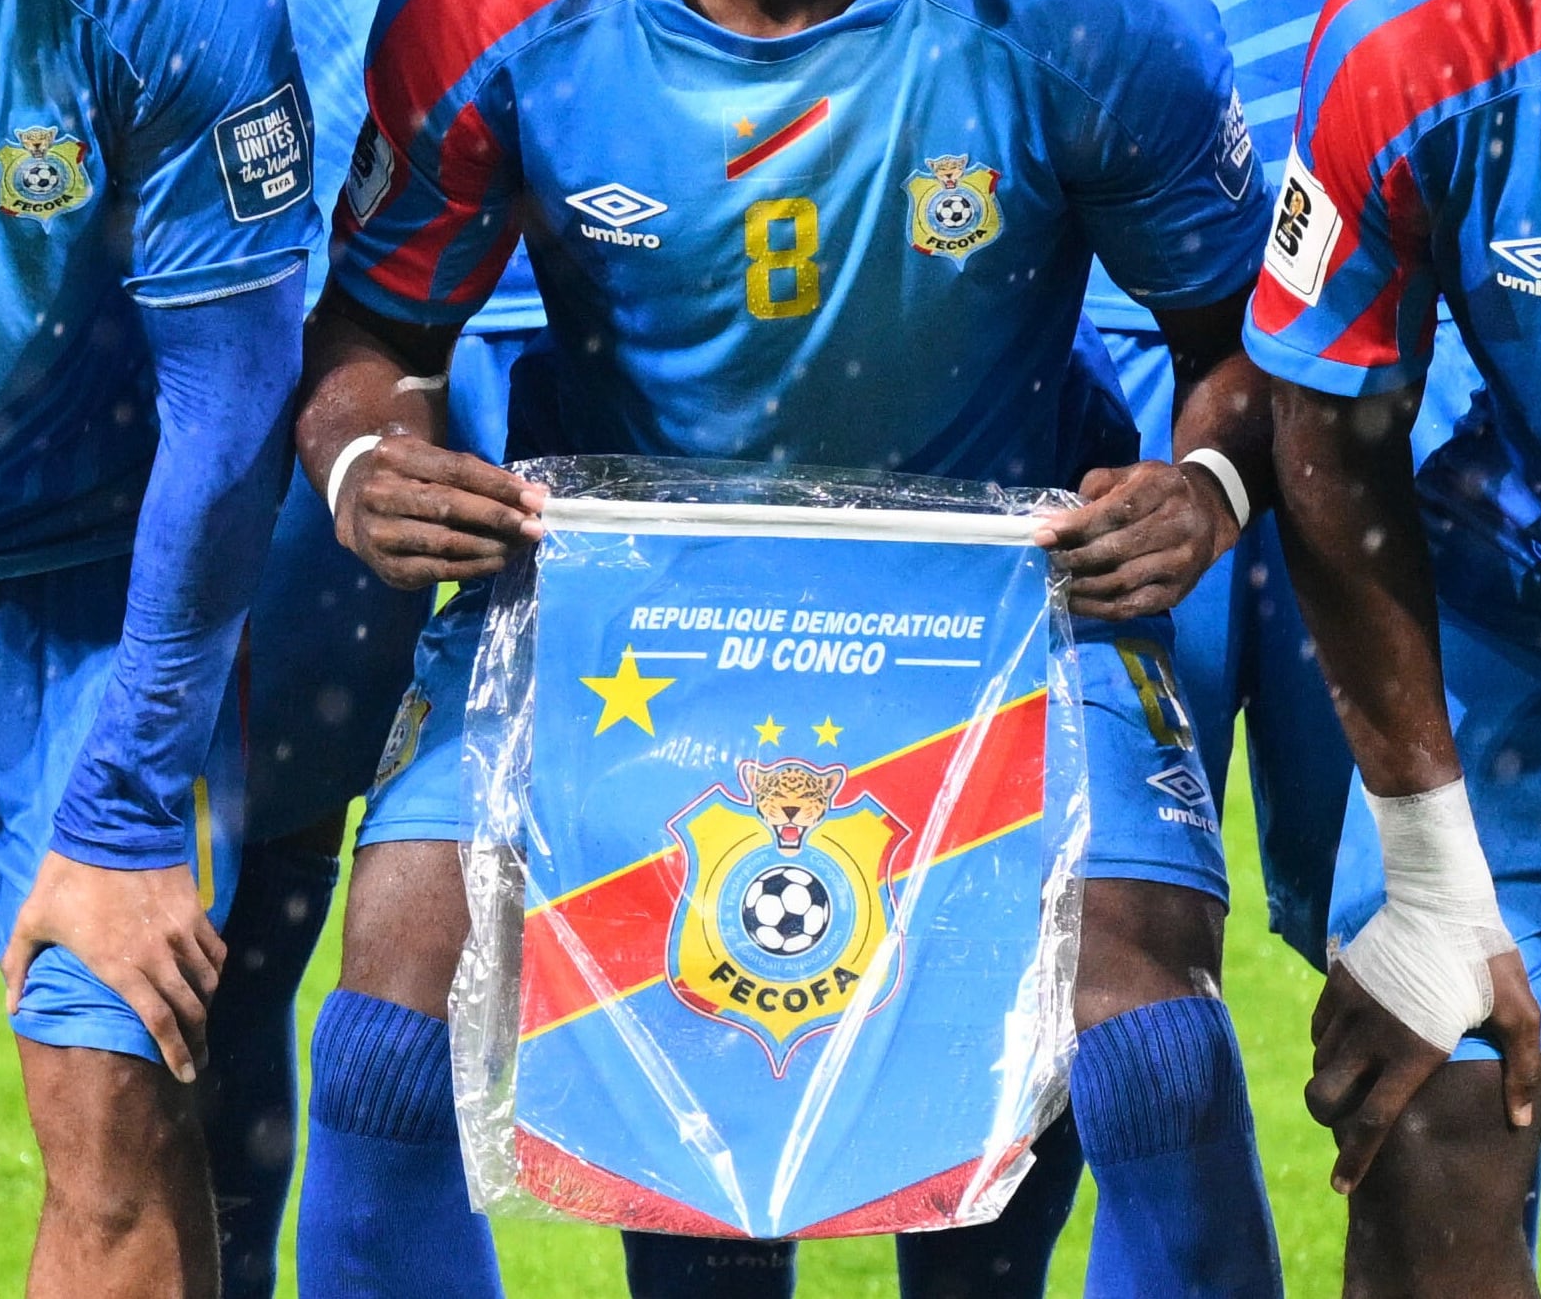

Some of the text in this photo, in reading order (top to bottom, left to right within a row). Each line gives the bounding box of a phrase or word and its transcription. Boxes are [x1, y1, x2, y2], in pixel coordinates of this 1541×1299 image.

[233, 106, 290, 140] FOOTBALL
[236, 122, 295, 163] UNITES
[238, 141, 301, 183] the World
[268, 177, 291, 193] FIFA
[12, 194, 74, 212] FECOFA
[581, 224, 660, 248] umbro
[926, 229, 987, 250] FECOFA
[745, 197, 820, 319] 8
[629, 606, 985, 639] REPUBLIQUE DEMOCRATIQUE
[717, 636, 886, 675] DU CONGO
[709, 961, 859, 1012] FECOFA
